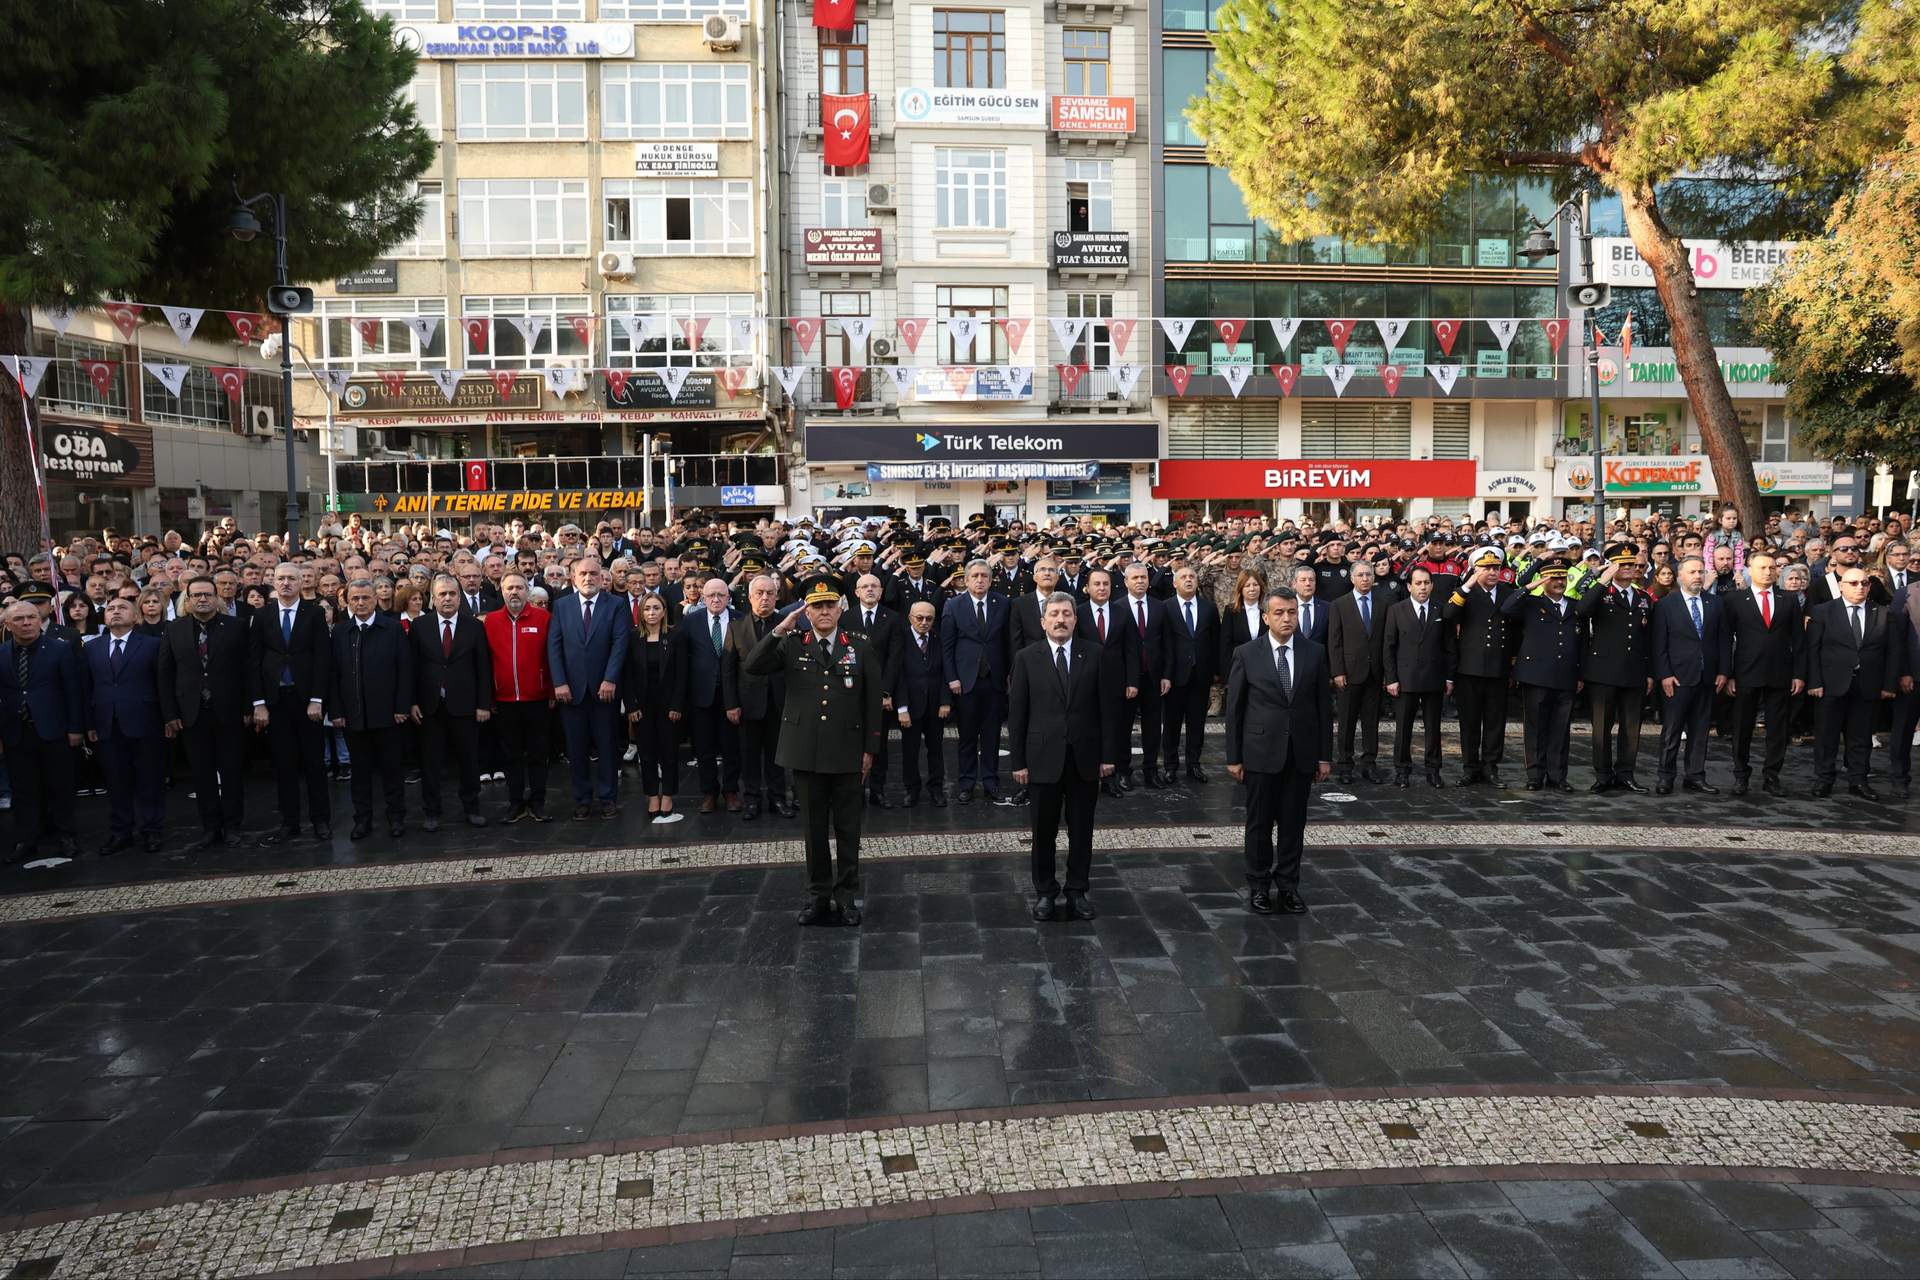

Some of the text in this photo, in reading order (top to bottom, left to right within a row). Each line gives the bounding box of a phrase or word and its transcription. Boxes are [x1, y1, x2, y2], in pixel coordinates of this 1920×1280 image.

[934, 95, 1039, 108] EĞİTİM GÜCÜ SEN
[1060, 97, 1109, 106] SEVDAMIZ
[1059, 106, 1127, 121] SAMSUN
[1059, 121, 1127, 129] GENEL MERKEZİ
[662, 144, 694, 152] DENGE
[676, 152, 713, 160] BÜROSU
[818, 243, 875, 251] AVUKAT
[1081, 244, 1122, 252] AVUKAT
[1056, 255, 1129, 264] FUAT SARIKAYA
[1629, 362, 1675, 383] TARIM
[460, 383, 531, 395] SENDİASI
[417, 415, 470, 425] KAHVALTI
[620, 411, 655, 421] KEBAP
[737, 410, 759, 418] 7/24
[54, 434, 107, 458] OBA
[944, 434, 1063, 451] Türk Telekom
[880, 464, 923, 479] SINIRSIZ
[951, 462, 996, 478] İNTERNET
[998, 463, 1043, 480] BAŞVURU
[924, 481, 951, 489] tivibu
[1487, 476, 1513, 492] AÇMAK
[394, 495, 440, 512] ANIT
[445, 493, 508, 512] TERME
[510, 490, 553, 511] PİDE
[557, 492, 585, 510] VE
